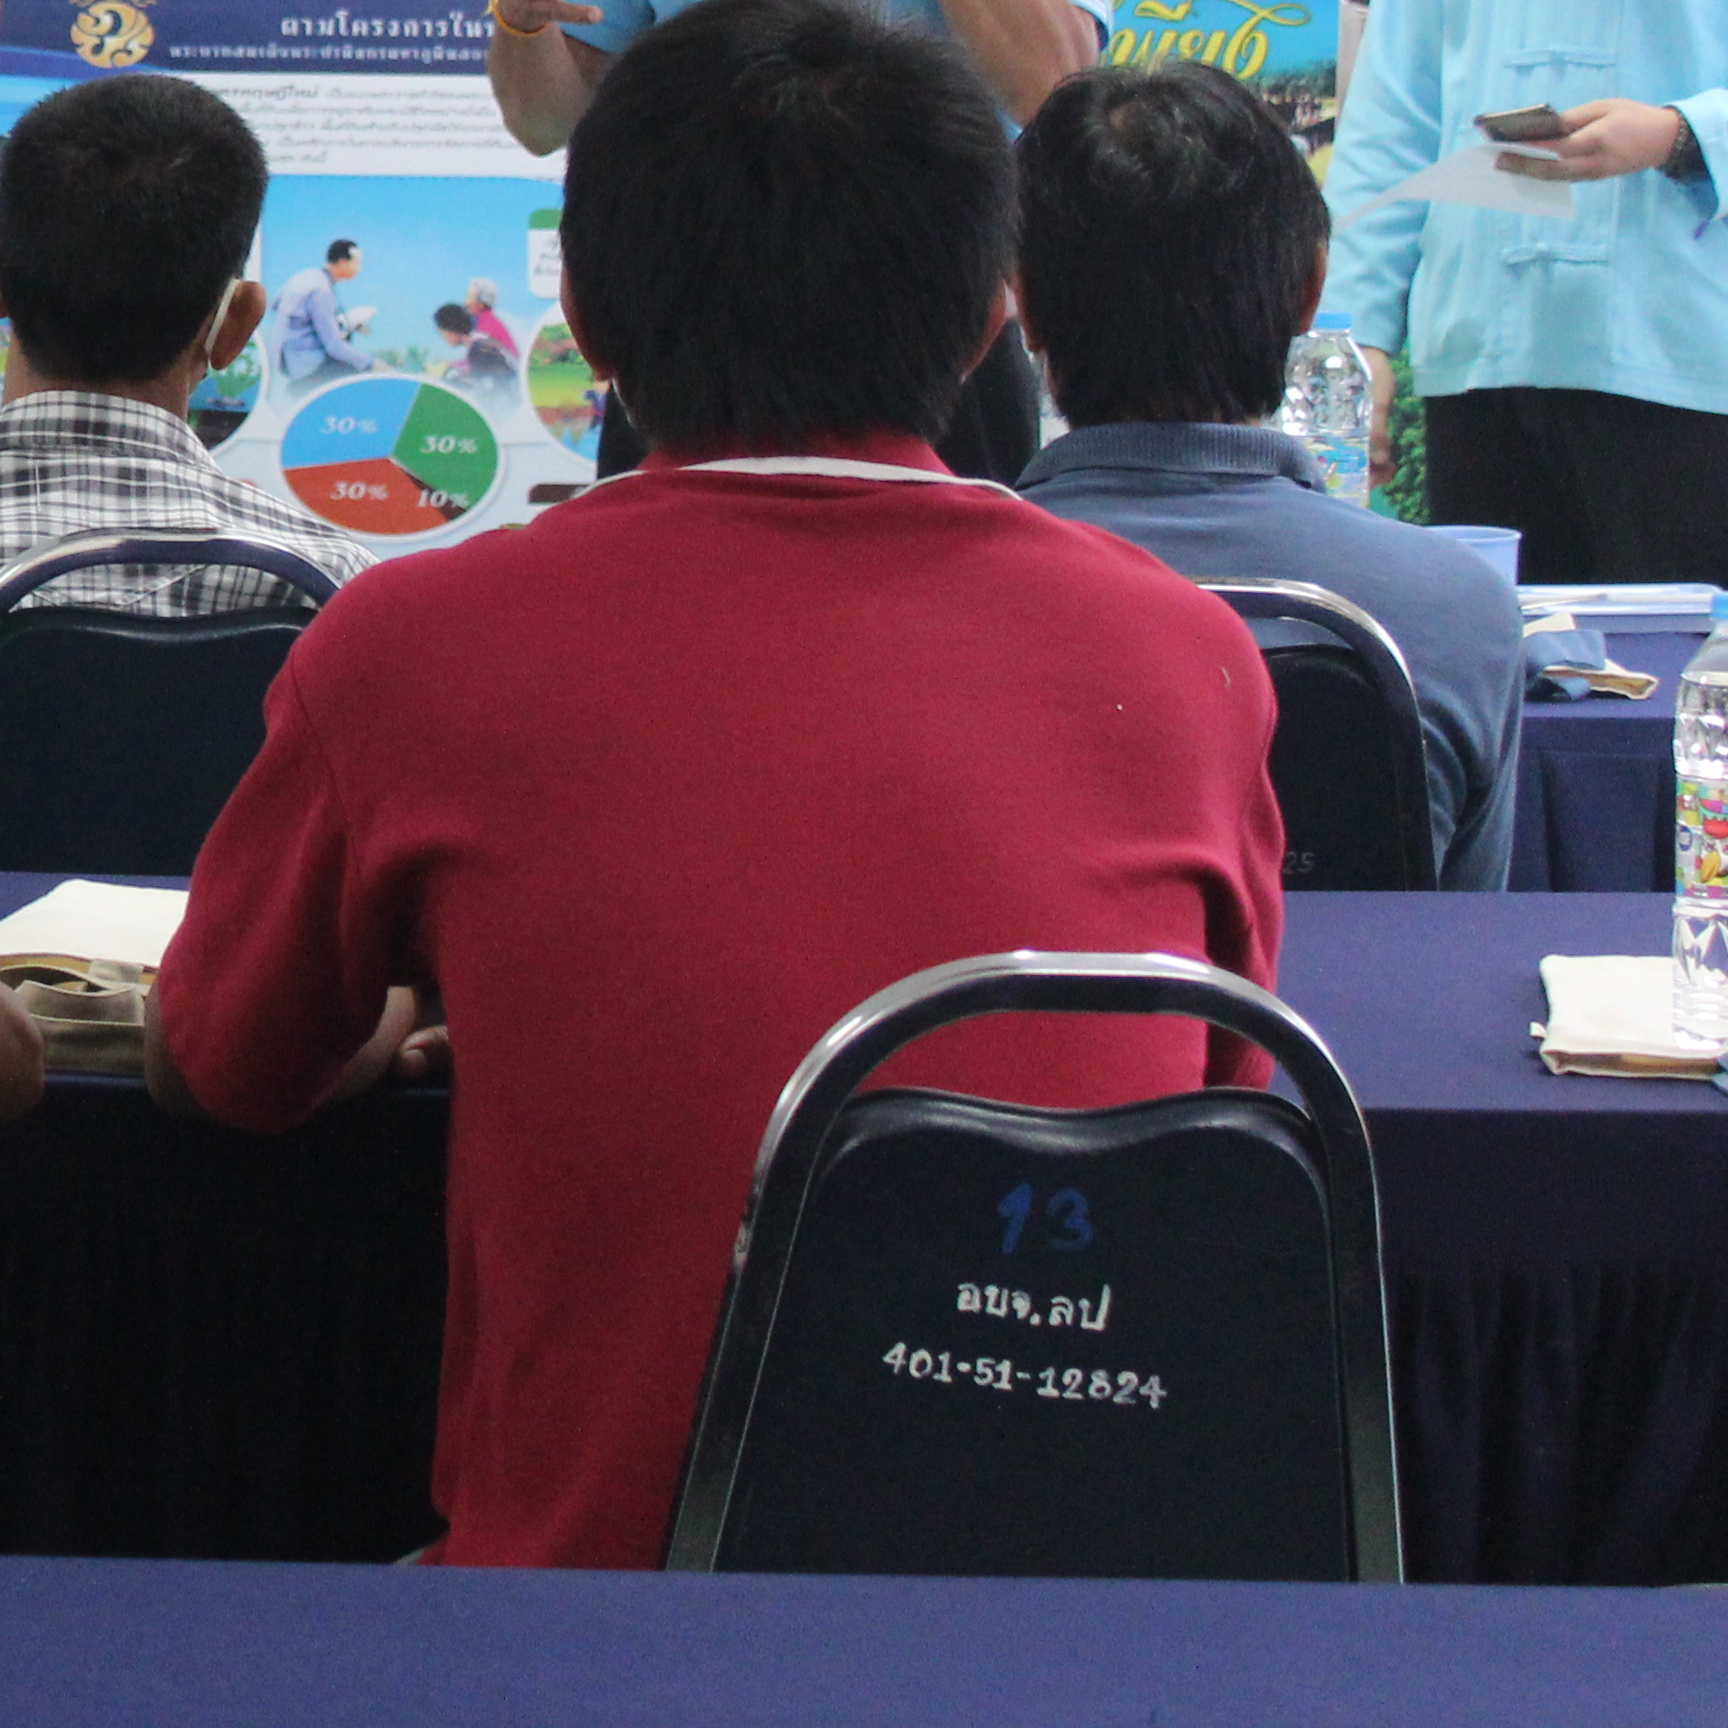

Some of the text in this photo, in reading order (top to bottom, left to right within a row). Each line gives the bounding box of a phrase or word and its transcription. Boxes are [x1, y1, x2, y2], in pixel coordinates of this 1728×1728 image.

[321, 416, 377, 434] 30%
[420, 435, 477, 454] 30%
[330, 481, 388, 500] 30%
[416, 489, 469, 508] 10%
[996, 1180, 1096, 1255] 13
[956, 1282, 1112, 1333] อบจ.ลป
